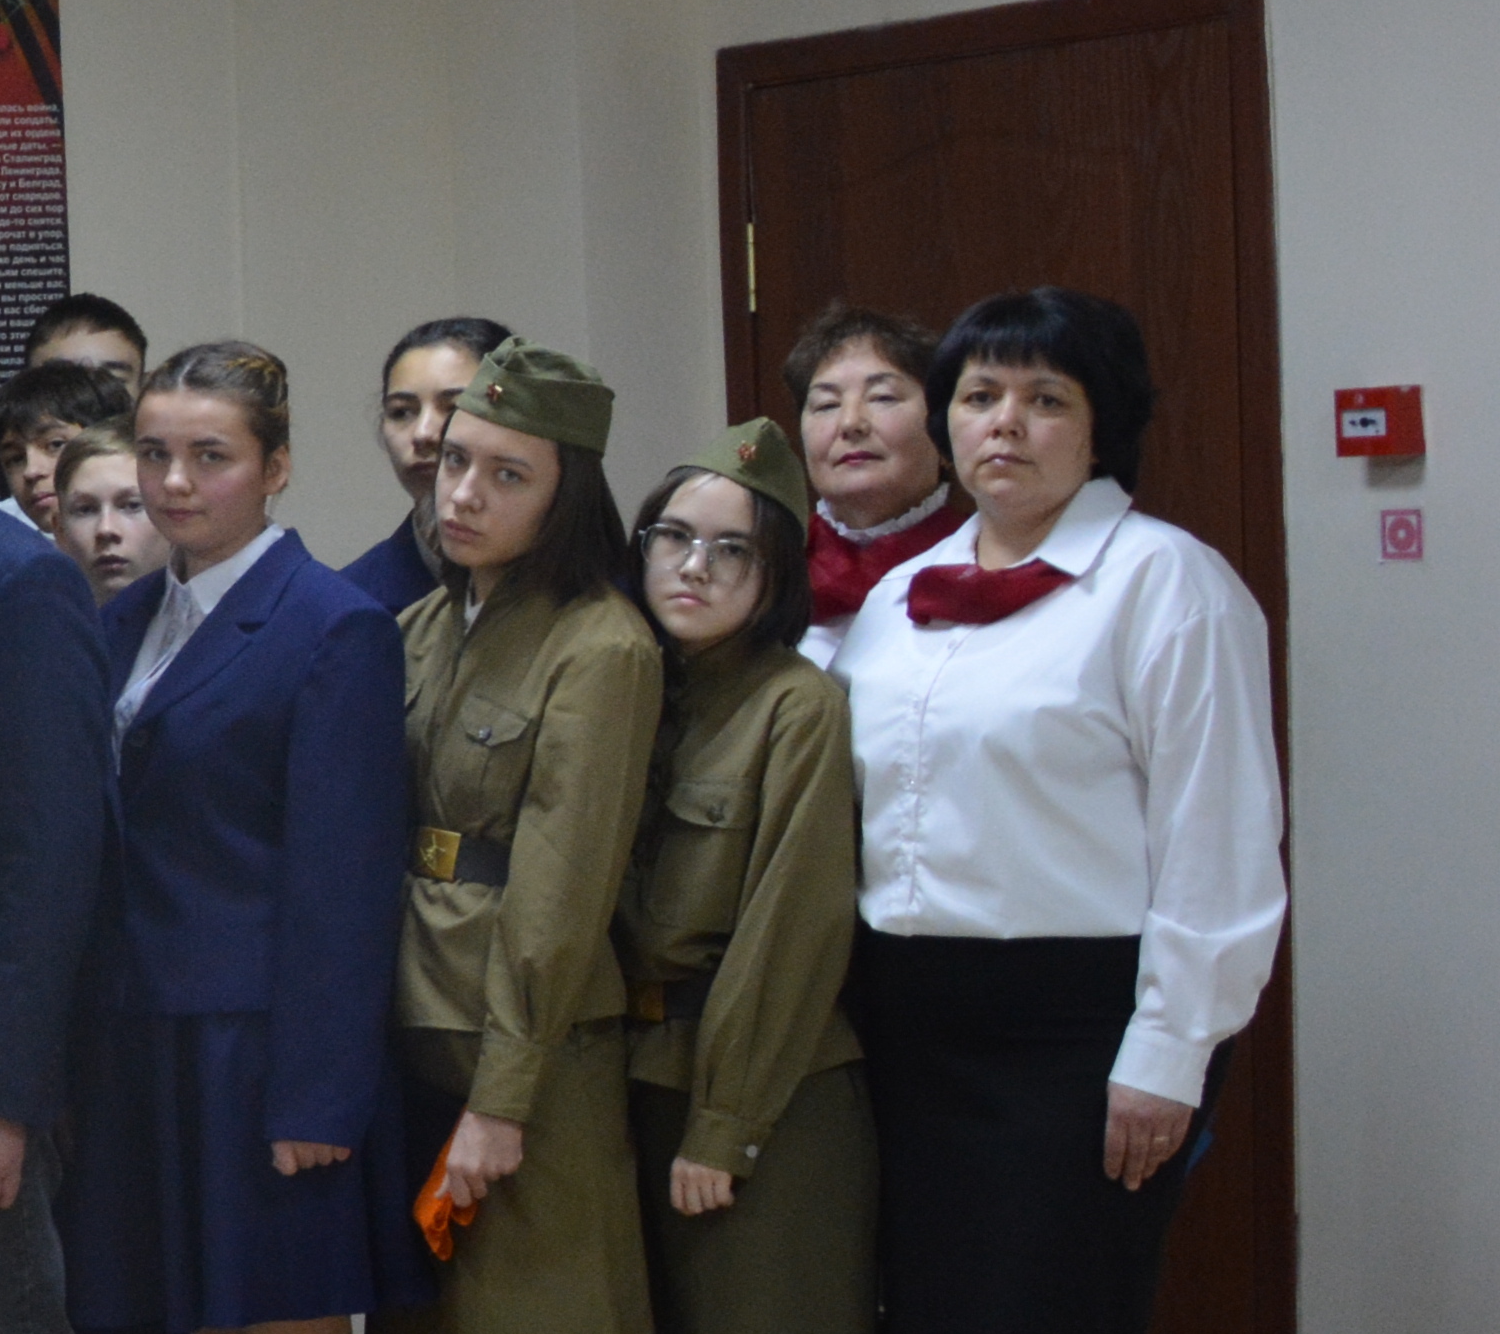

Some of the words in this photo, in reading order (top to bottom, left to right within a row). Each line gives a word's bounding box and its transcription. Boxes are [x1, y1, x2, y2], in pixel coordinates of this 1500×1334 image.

[25, 129, 60, 138] ордена
[3, 154, 62, 163] Сталинград
[10, 206, 22, 215] до
[46, 205, 63, 214] пор
[12, 256, 37, 264] день
[4, 281, 44, 289] меньше
